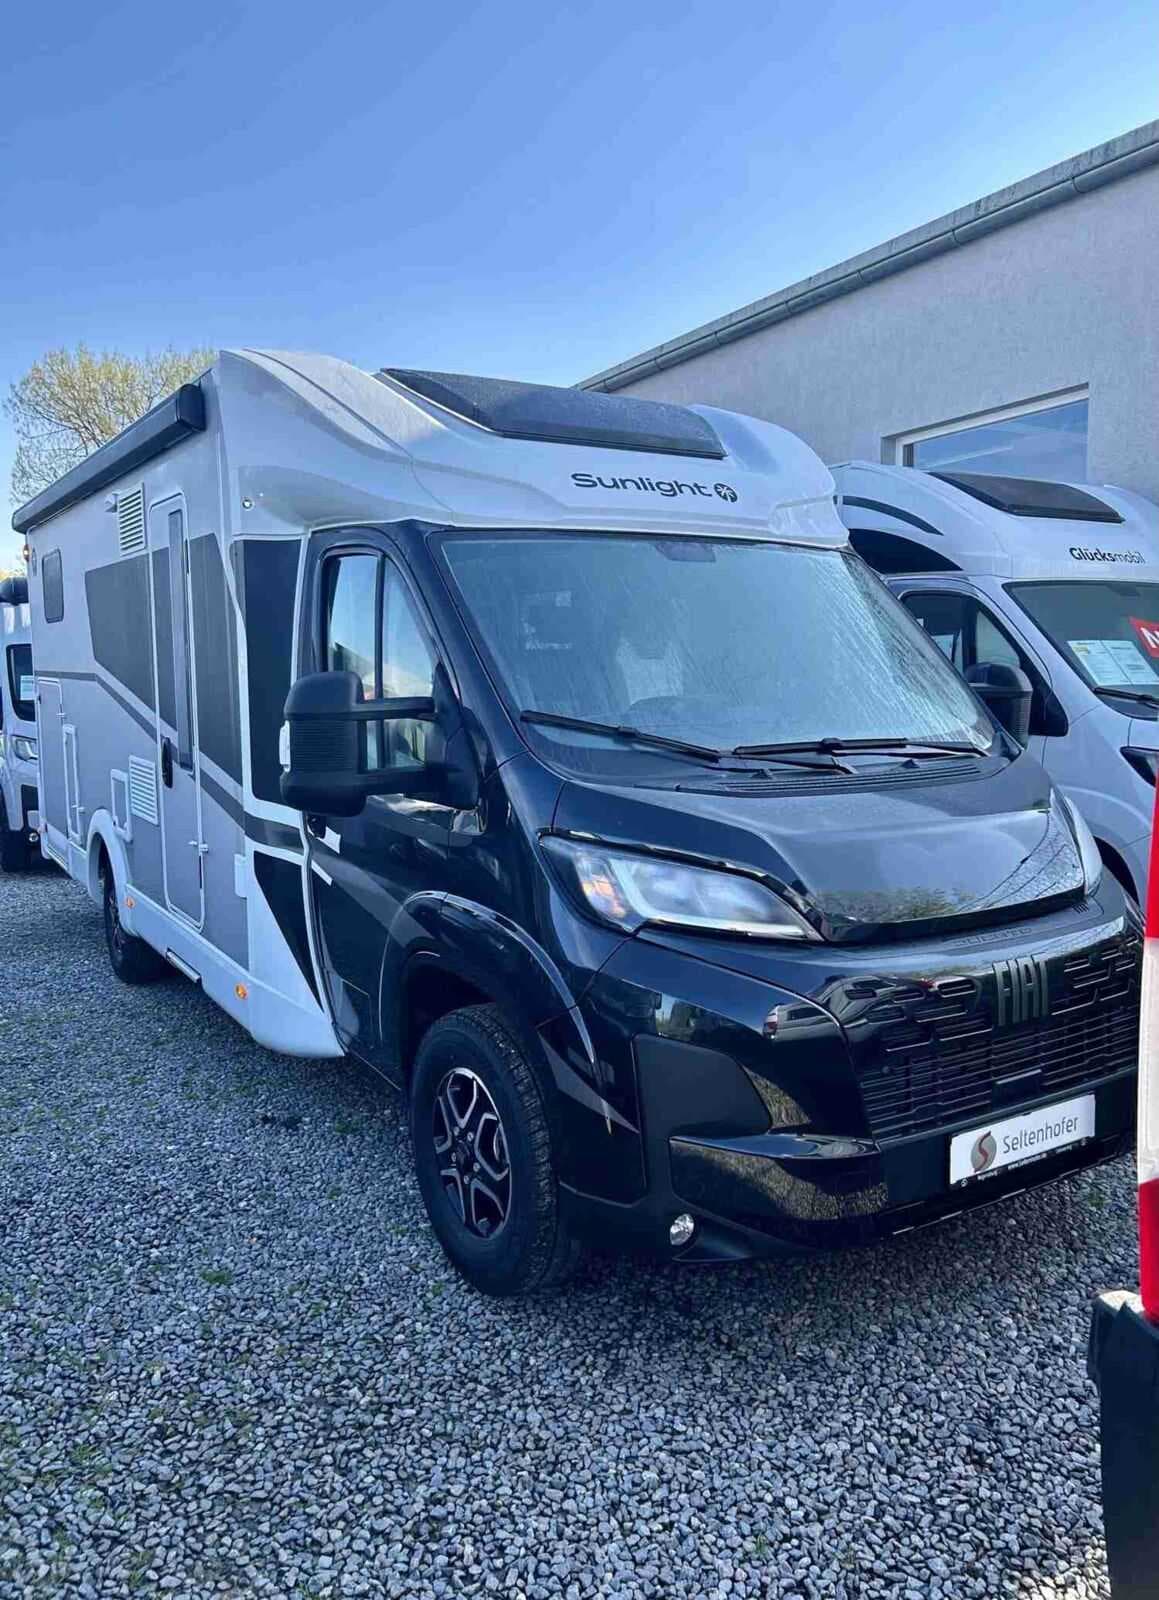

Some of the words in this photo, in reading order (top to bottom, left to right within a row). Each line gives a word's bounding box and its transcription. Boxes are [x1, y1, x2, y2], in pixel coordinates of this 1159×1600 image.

[571, 472, 713, 498] Sunlight
[1068, 546, 1146, 564] Glücksmobil
[992, 953, 1049, 1027] FIAT
[1002, 1116, 1079, 1154] Seltenhofer
